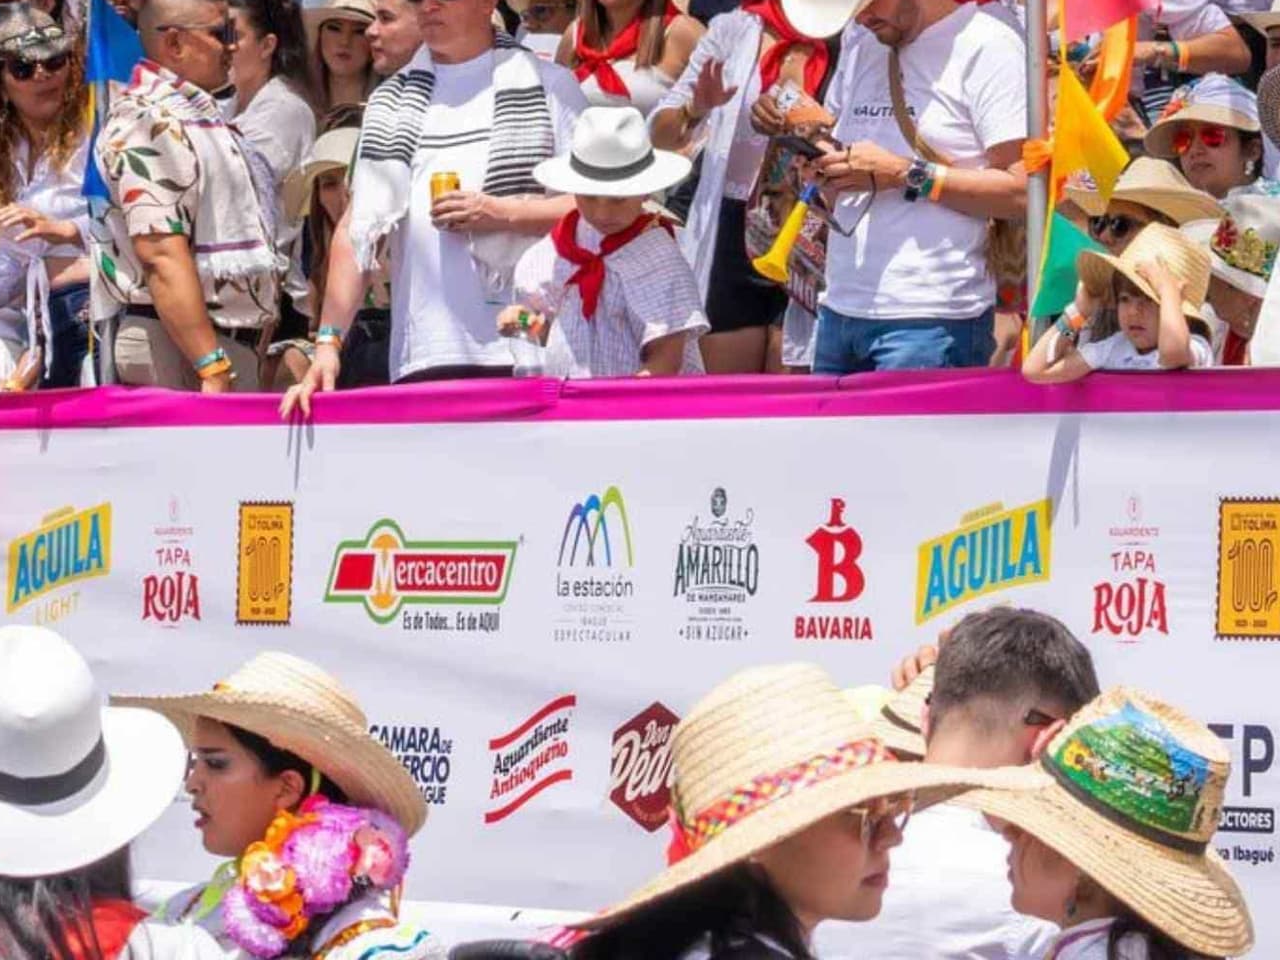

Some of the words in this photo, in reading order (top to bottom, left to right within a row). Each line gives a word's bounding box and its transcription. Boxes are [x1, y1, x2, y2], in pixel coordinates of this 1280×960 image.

[13, 513, 104, 603] AGUILA
[155, 548, 191, 566] TAPA
[374, 550, 497, 596] Mercacentro
[673, 543, 759, 597] AMARILLO
[923, 510, 1042, 616] AGUILA
[1110, 551, 1155, 573] TAPA
[35, 591, 81, 626] LIGHT
[142, 571, 201, 622] ROJA
[556, 572, 569, 597] la
[573, 573, 634, 597] estación
[1091, 577, 1169, 636] ROJA
[795, 616, 872, 640] BAVARIA
[397, 755, 450, 783] ERCIO
[490, 737, 568, 799] Antioqueño
[493, 717, 568, 776] Aguardiente
[612, 730, 677, 802] Ped
[1233, 845, 1275, 865] Ibagué
